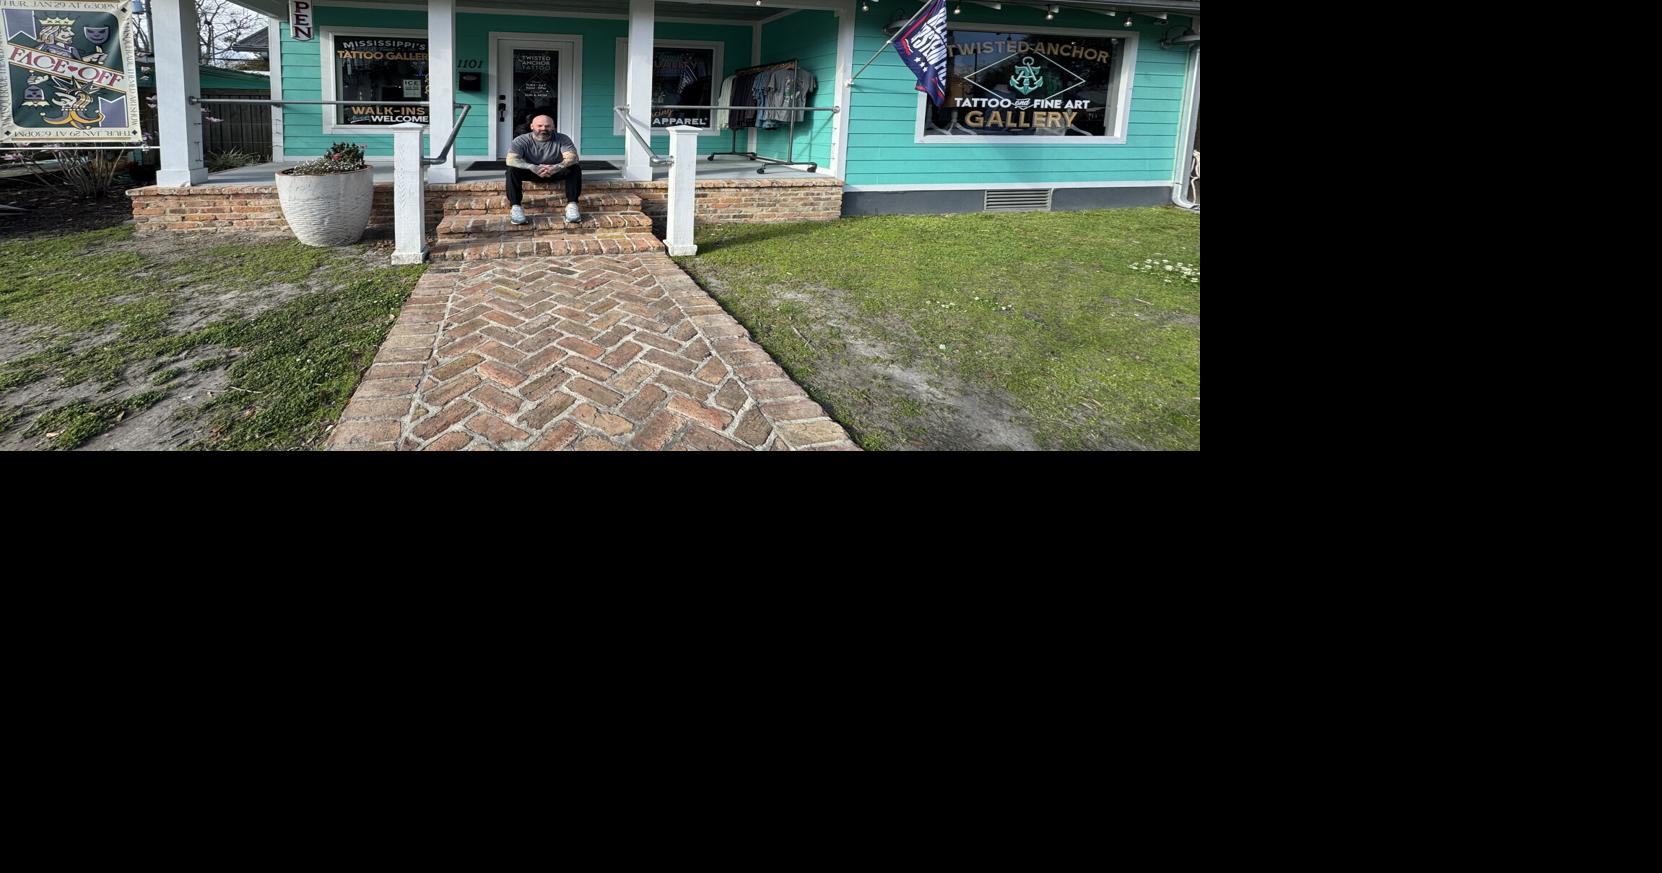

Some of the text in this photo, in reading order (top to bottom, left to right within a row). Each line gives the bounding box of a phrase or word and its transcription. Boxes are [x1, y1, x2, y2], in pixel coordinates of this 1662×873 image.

[294, 0, 312, 40] PEN
[342, 39, 426, 51] MISSISSIPPI'S
[336, 50, 429, 61] TATTOO GALLER
[947, 40, 1109, 64] TWISTED ANCHOR
[954, 97, 1012, 108] TATTOO
[1033, 98, 1062, 109] FINE
[1064, 99, 1091, 110] ART
[351, 106, 426, 116] WALK-INS
[371, 115, 429, 123] WELCOME
[652, 117, 706, 126] APPAREL
[964, 110, 1078, 129] GALLERY
